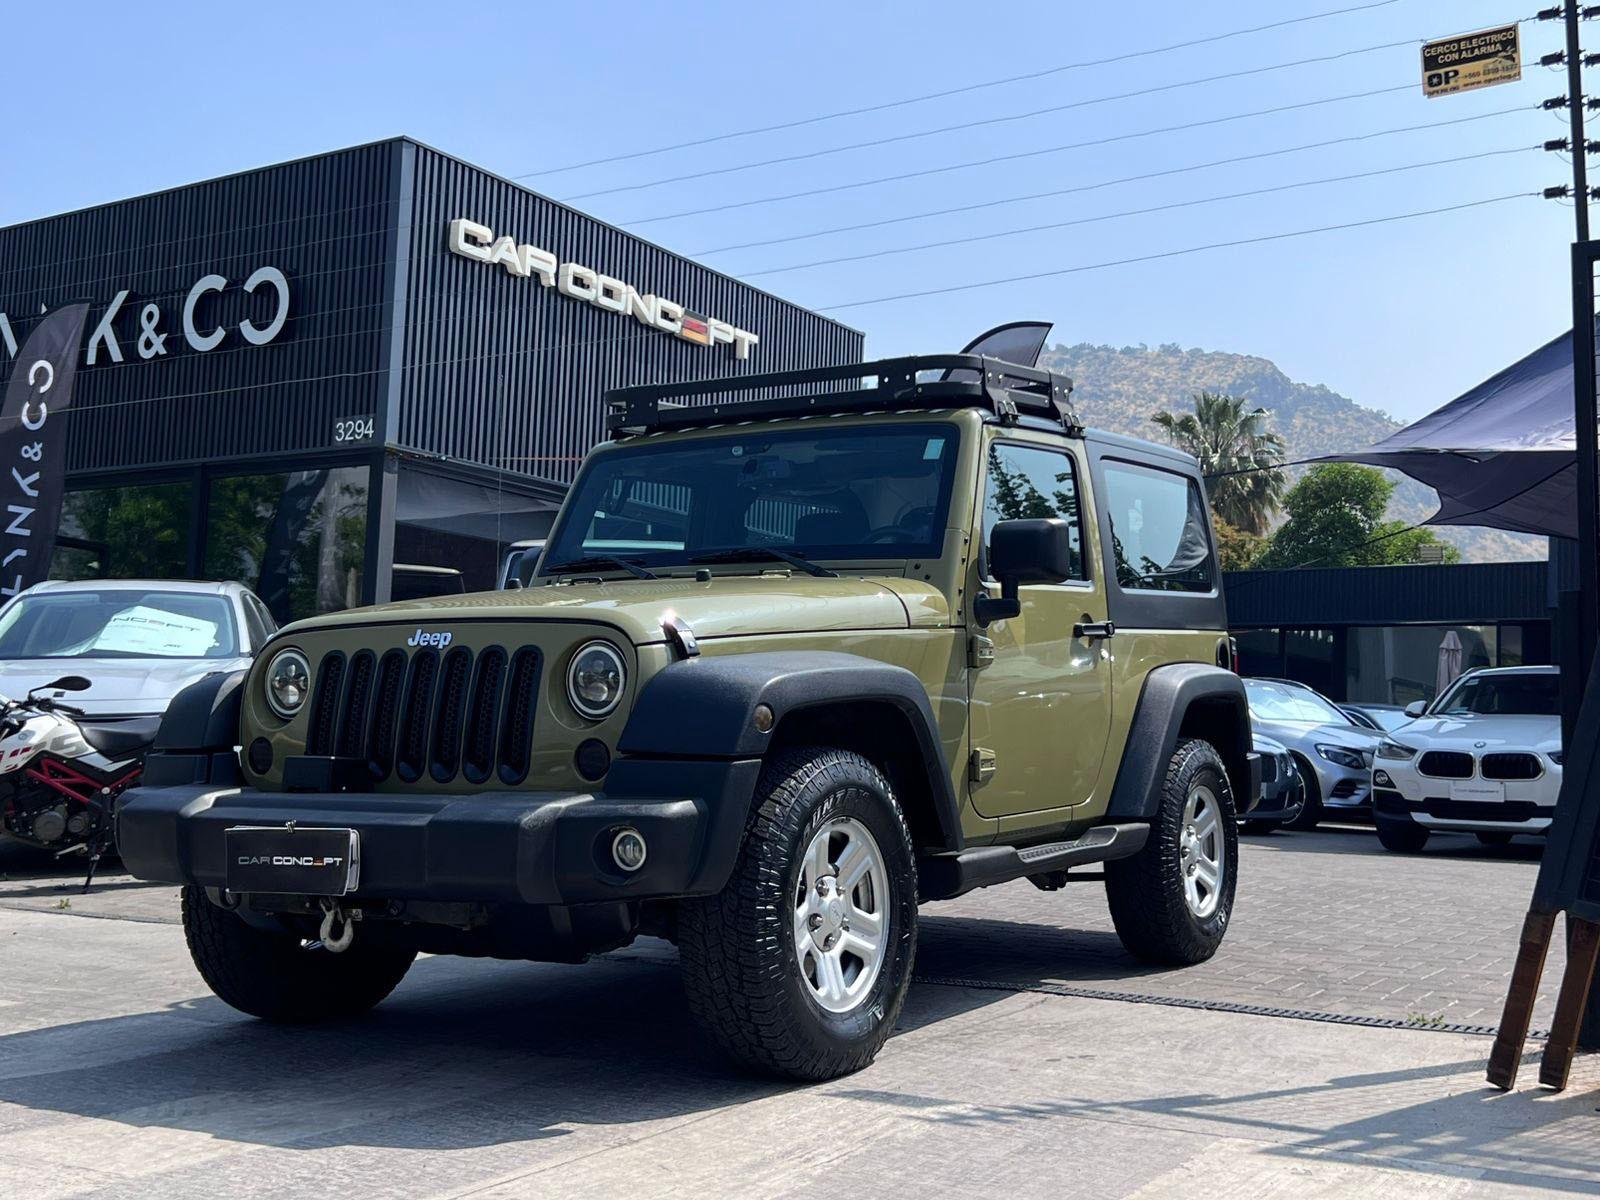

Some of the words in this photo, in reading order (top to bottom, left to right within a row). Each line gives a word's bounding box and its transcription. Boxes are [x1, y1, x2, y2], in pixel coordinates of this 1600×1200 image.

[1424, 43, 1458, 57] CERCO
[1460, 30, 1515, 50] ELECTRICO
[1438, 52, 1460, 64] CON
[1461, 43, 1503, 59] ALARMA
[449, 218, 557, 288] CAR
[558, 262, 758, 360] CONCEPT
[335, 418, 375, 442] 3294
[407, 628, 452, 650] Jeep
[238, 856, 271, 866] CAR
